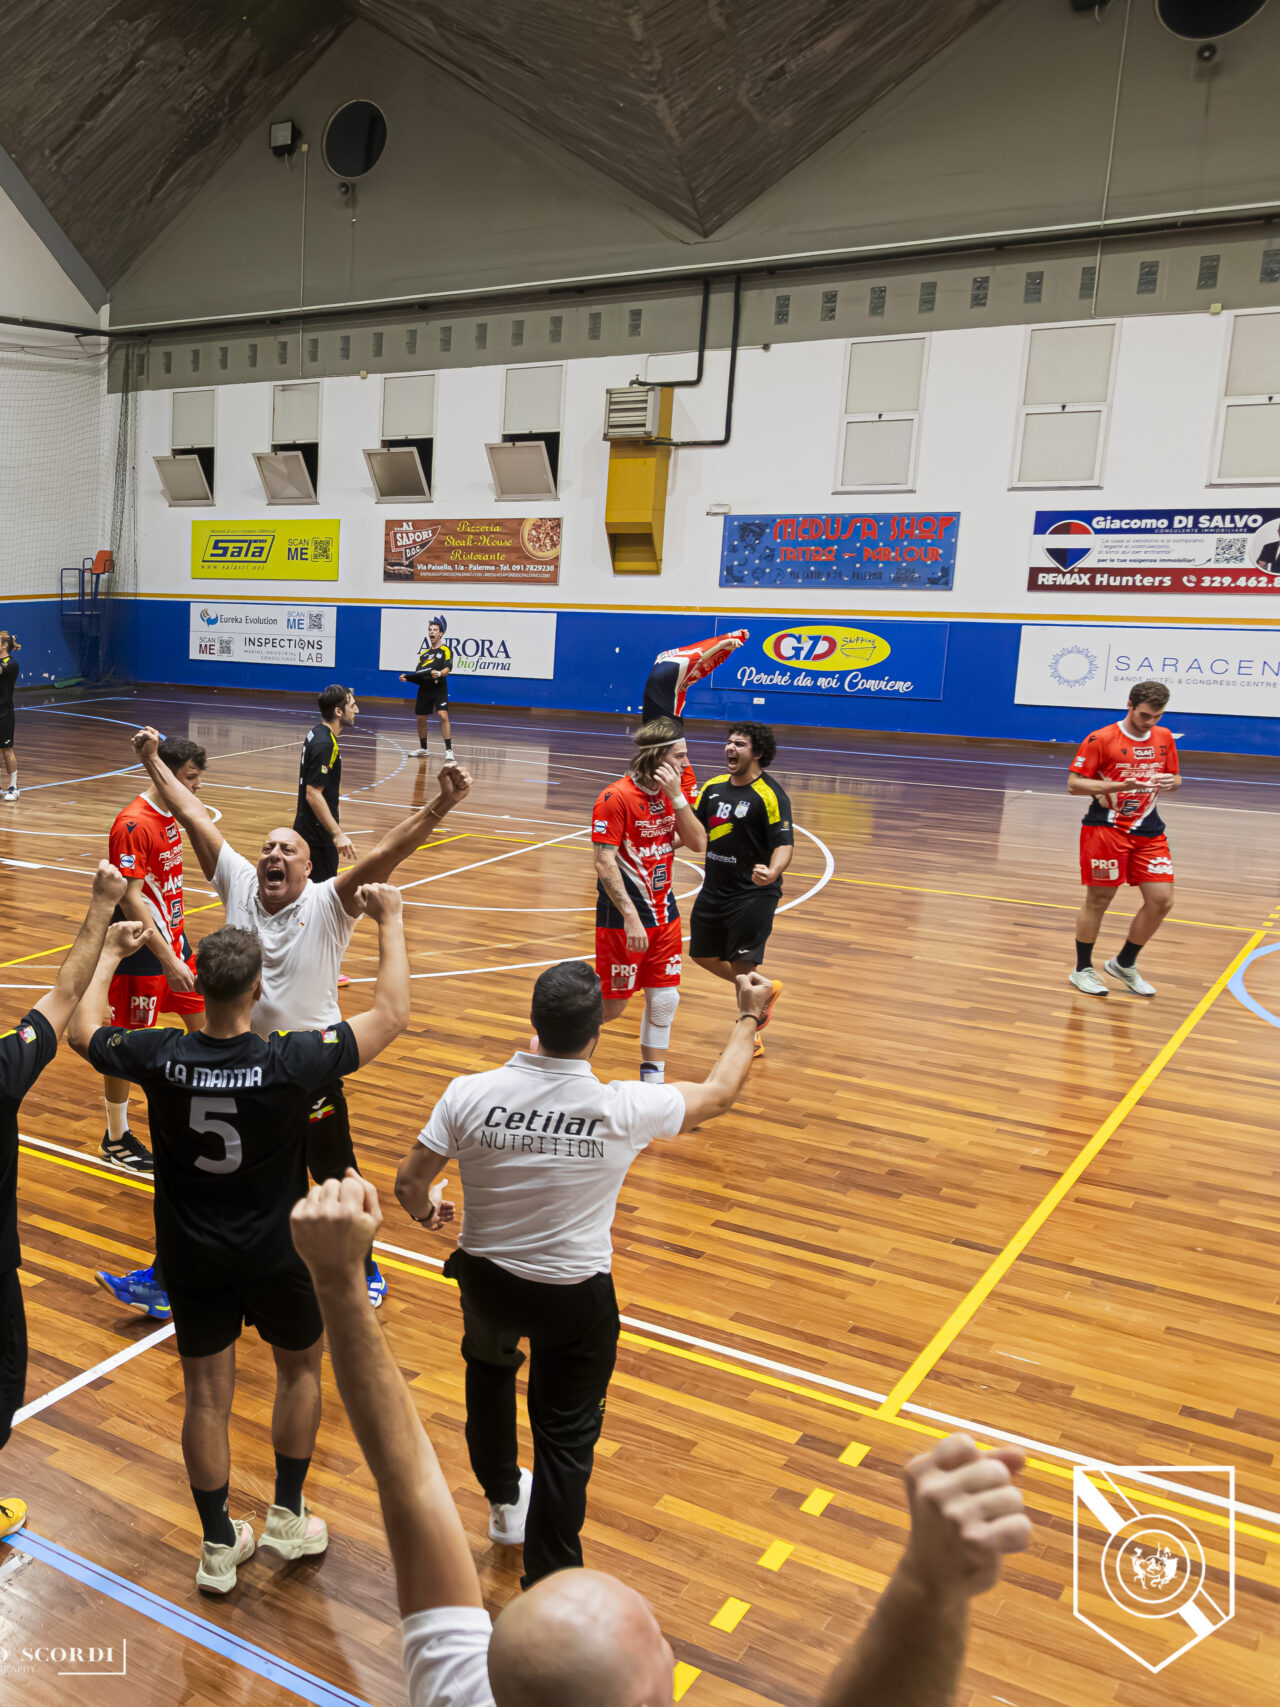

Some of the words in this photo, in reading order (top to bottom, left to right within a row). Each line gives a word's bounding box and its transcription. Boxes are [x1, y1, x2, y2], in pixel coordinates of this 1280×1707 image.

[456, 520, 501, 533] Pizzeria
[890, 515, 956, 541] SHOP
[1091, 516, 1169, 529] Giacomo
[1173, 515, 1194, 528] DI
[1198, 514, 1263, 528] SALVO
[287, 538, 310, 547] SCAN
[396, 530, 433, 546] SAPORI
[444, 535, 513, 547] Steak-House
[287, 547, 309, 561] ME
[406, 546, 423, 559] D.O.C.
[449, 549, 506, 561] Ristorante
[779, 547, 836, 562] TATTOO
[863, 546, 942, 562] PARLOUR
[417, 563, 427, 571] Via
[1095, 573, 1172, 587] Hunters
[220, 614, 243, 624] Eureka
[245, 616, 278, 625] Evolution
[286, 618, 305, 630] ME
[199, 636, 216, 644] SCAN
[244, 636, 323, 651] INSPECTIONS
[198, 644, 216, 655] ME
[417, 637, 512, 659] ARORA
[298, 652, 323, 663] LAB
[456, 656, 511, 672] biofarma
[1115, 655, 1280, 677] SARACEN
[737, 666, 791, 687] Perché
[793, 671, 813, 687] da
[816, 674, 841, 688] noi
[844, 671, 914, 694] Conviene
[1185, 678, 1238, 687] CONGRESS
[1240, 680, 1278, 688] CENTRE
[716, 801, 732, 819] 18
[1090, 858, 1119, 870] PRO
[611, 963, 638, 977] PRO
[130, 996, 157, 1010] PRO
[165, 1060, 187, 1085] LA
[192, 1066, 263, 1088] MANTIA
[484, 1105, 604, 1137] Cetilar
[189, 1096, 243, 1175] 5
[480, 1129, 605, 1158] NUTRITION
